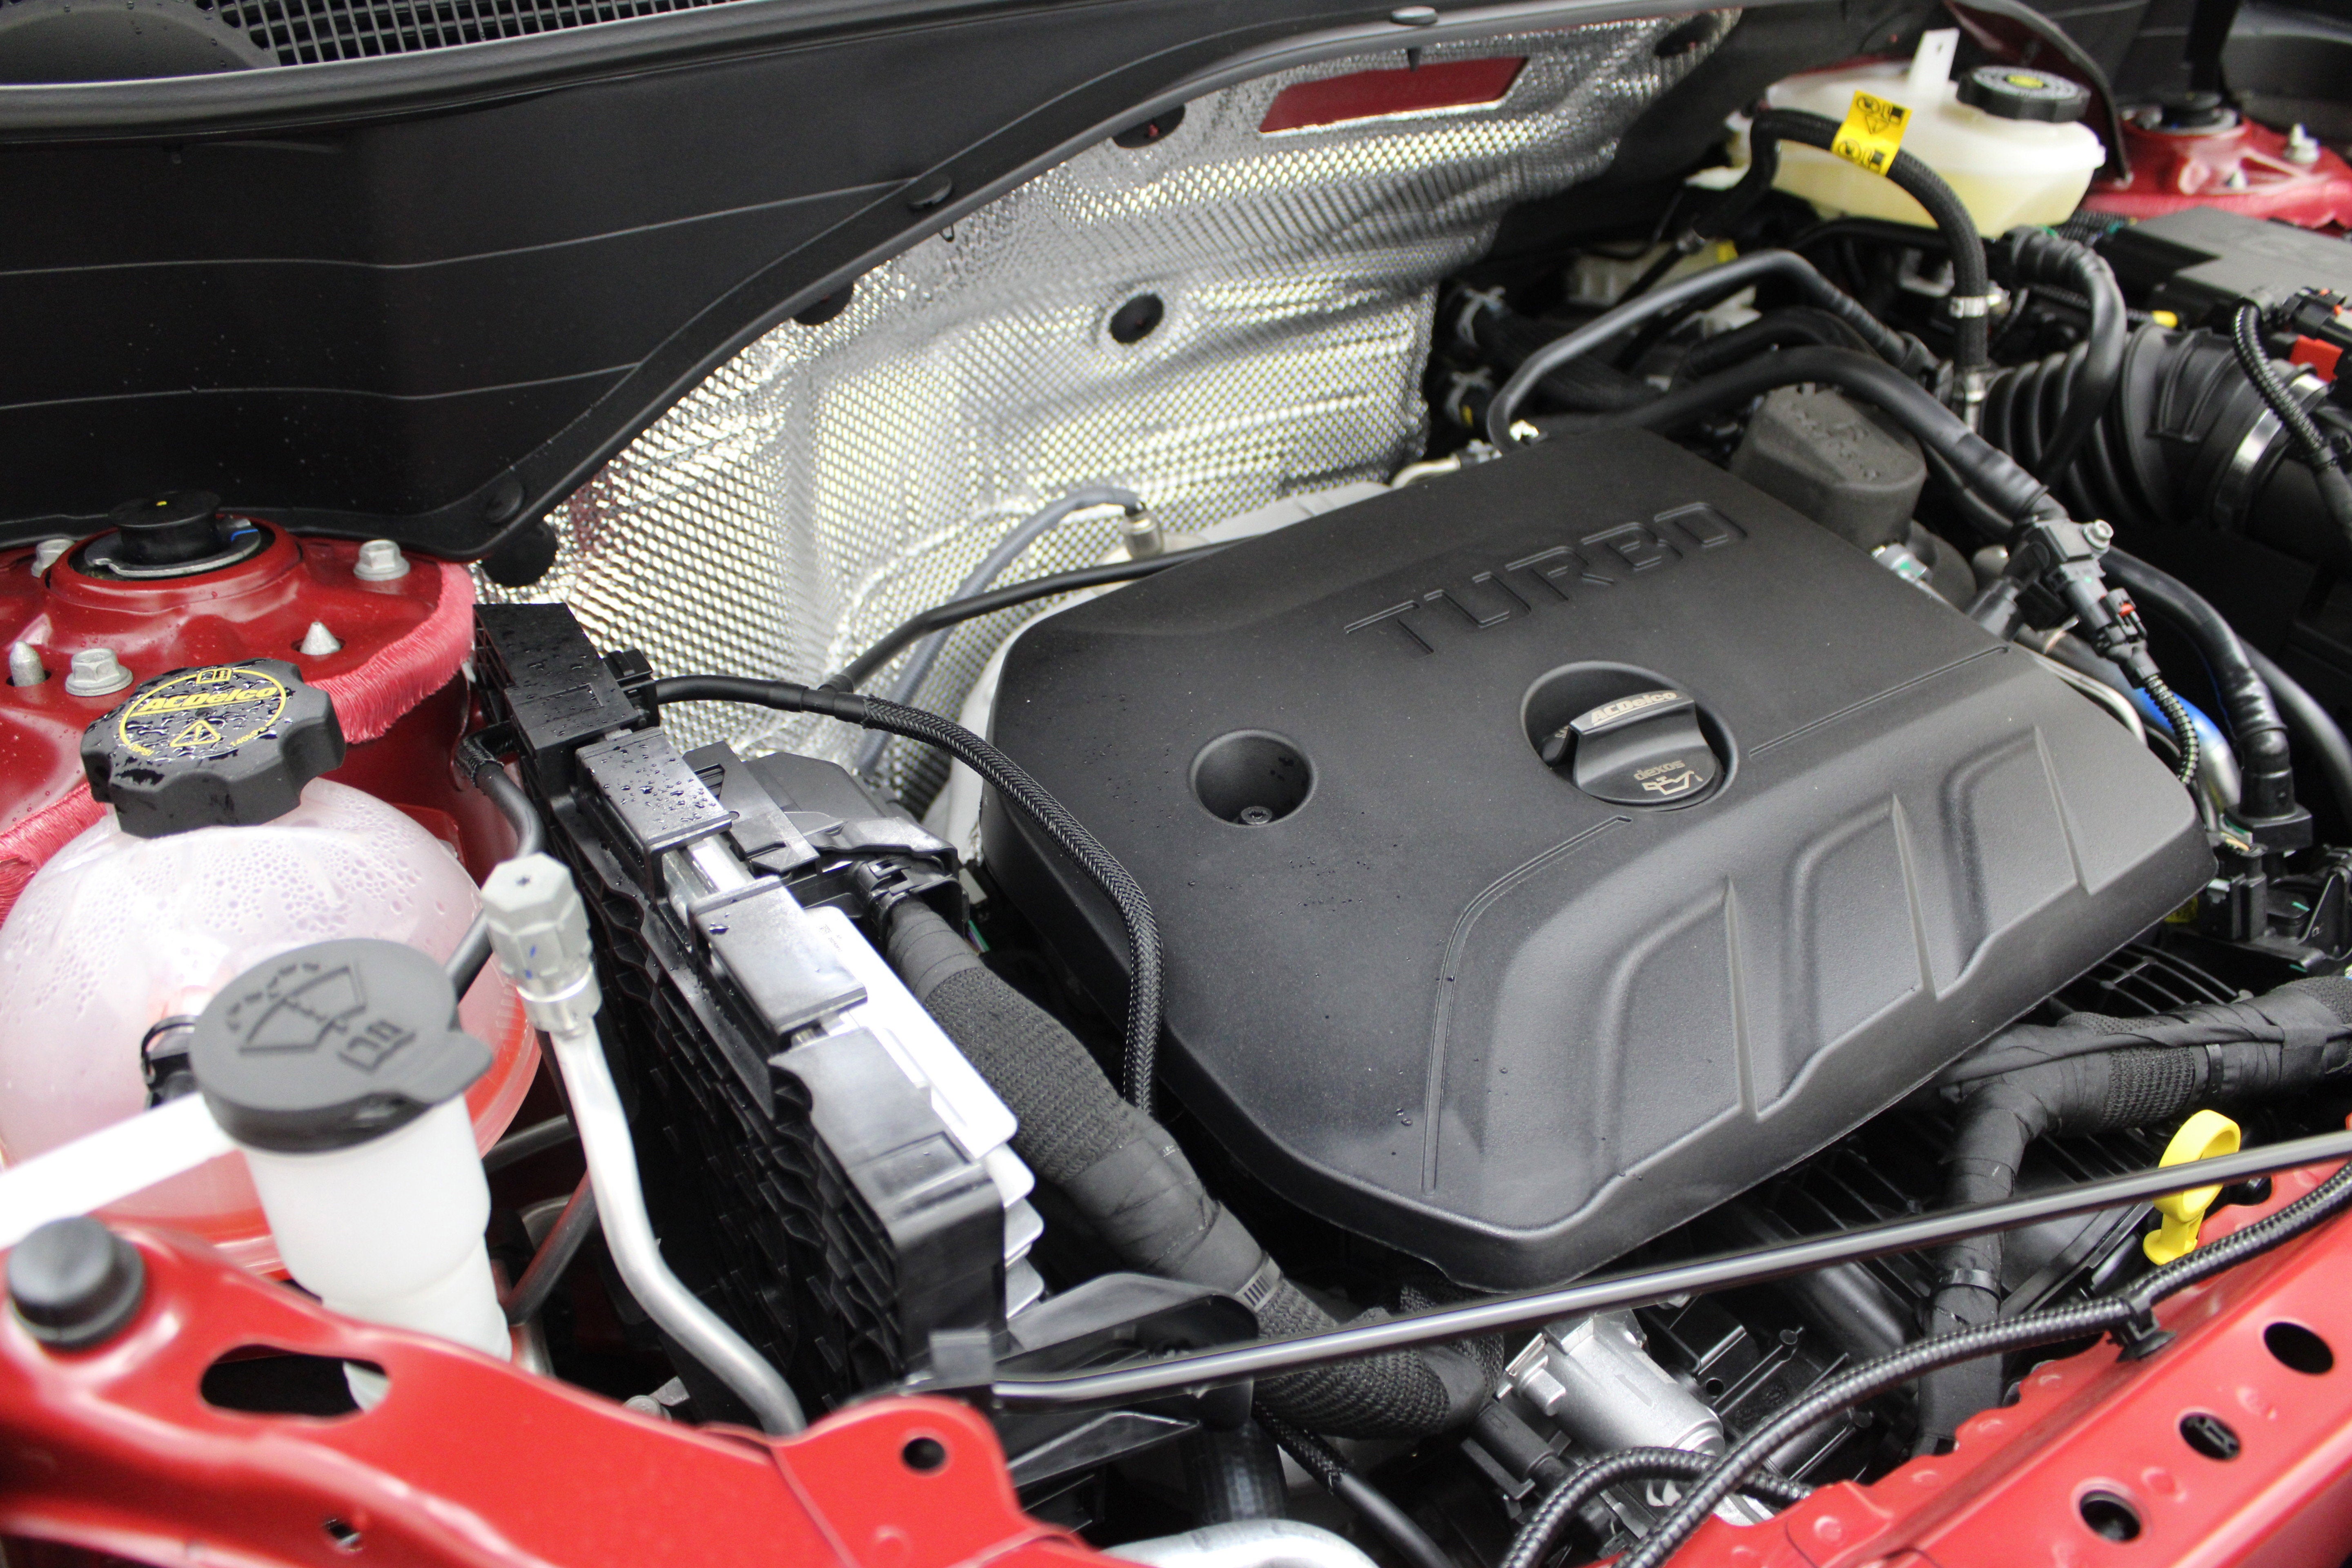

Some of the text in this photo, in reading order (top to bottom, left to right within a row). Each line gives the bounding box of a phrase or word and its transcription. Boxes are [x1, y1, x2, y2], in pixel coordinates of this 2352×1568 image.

[1343, 501, 1748, 654] TURBO
[138, 687, 278, 712] ACDelco
[1592, 693, 1677, 722] ACDelco
[129, 744, 154, 756] 20PSI
[1634, 760, 1685, 780] dexos
